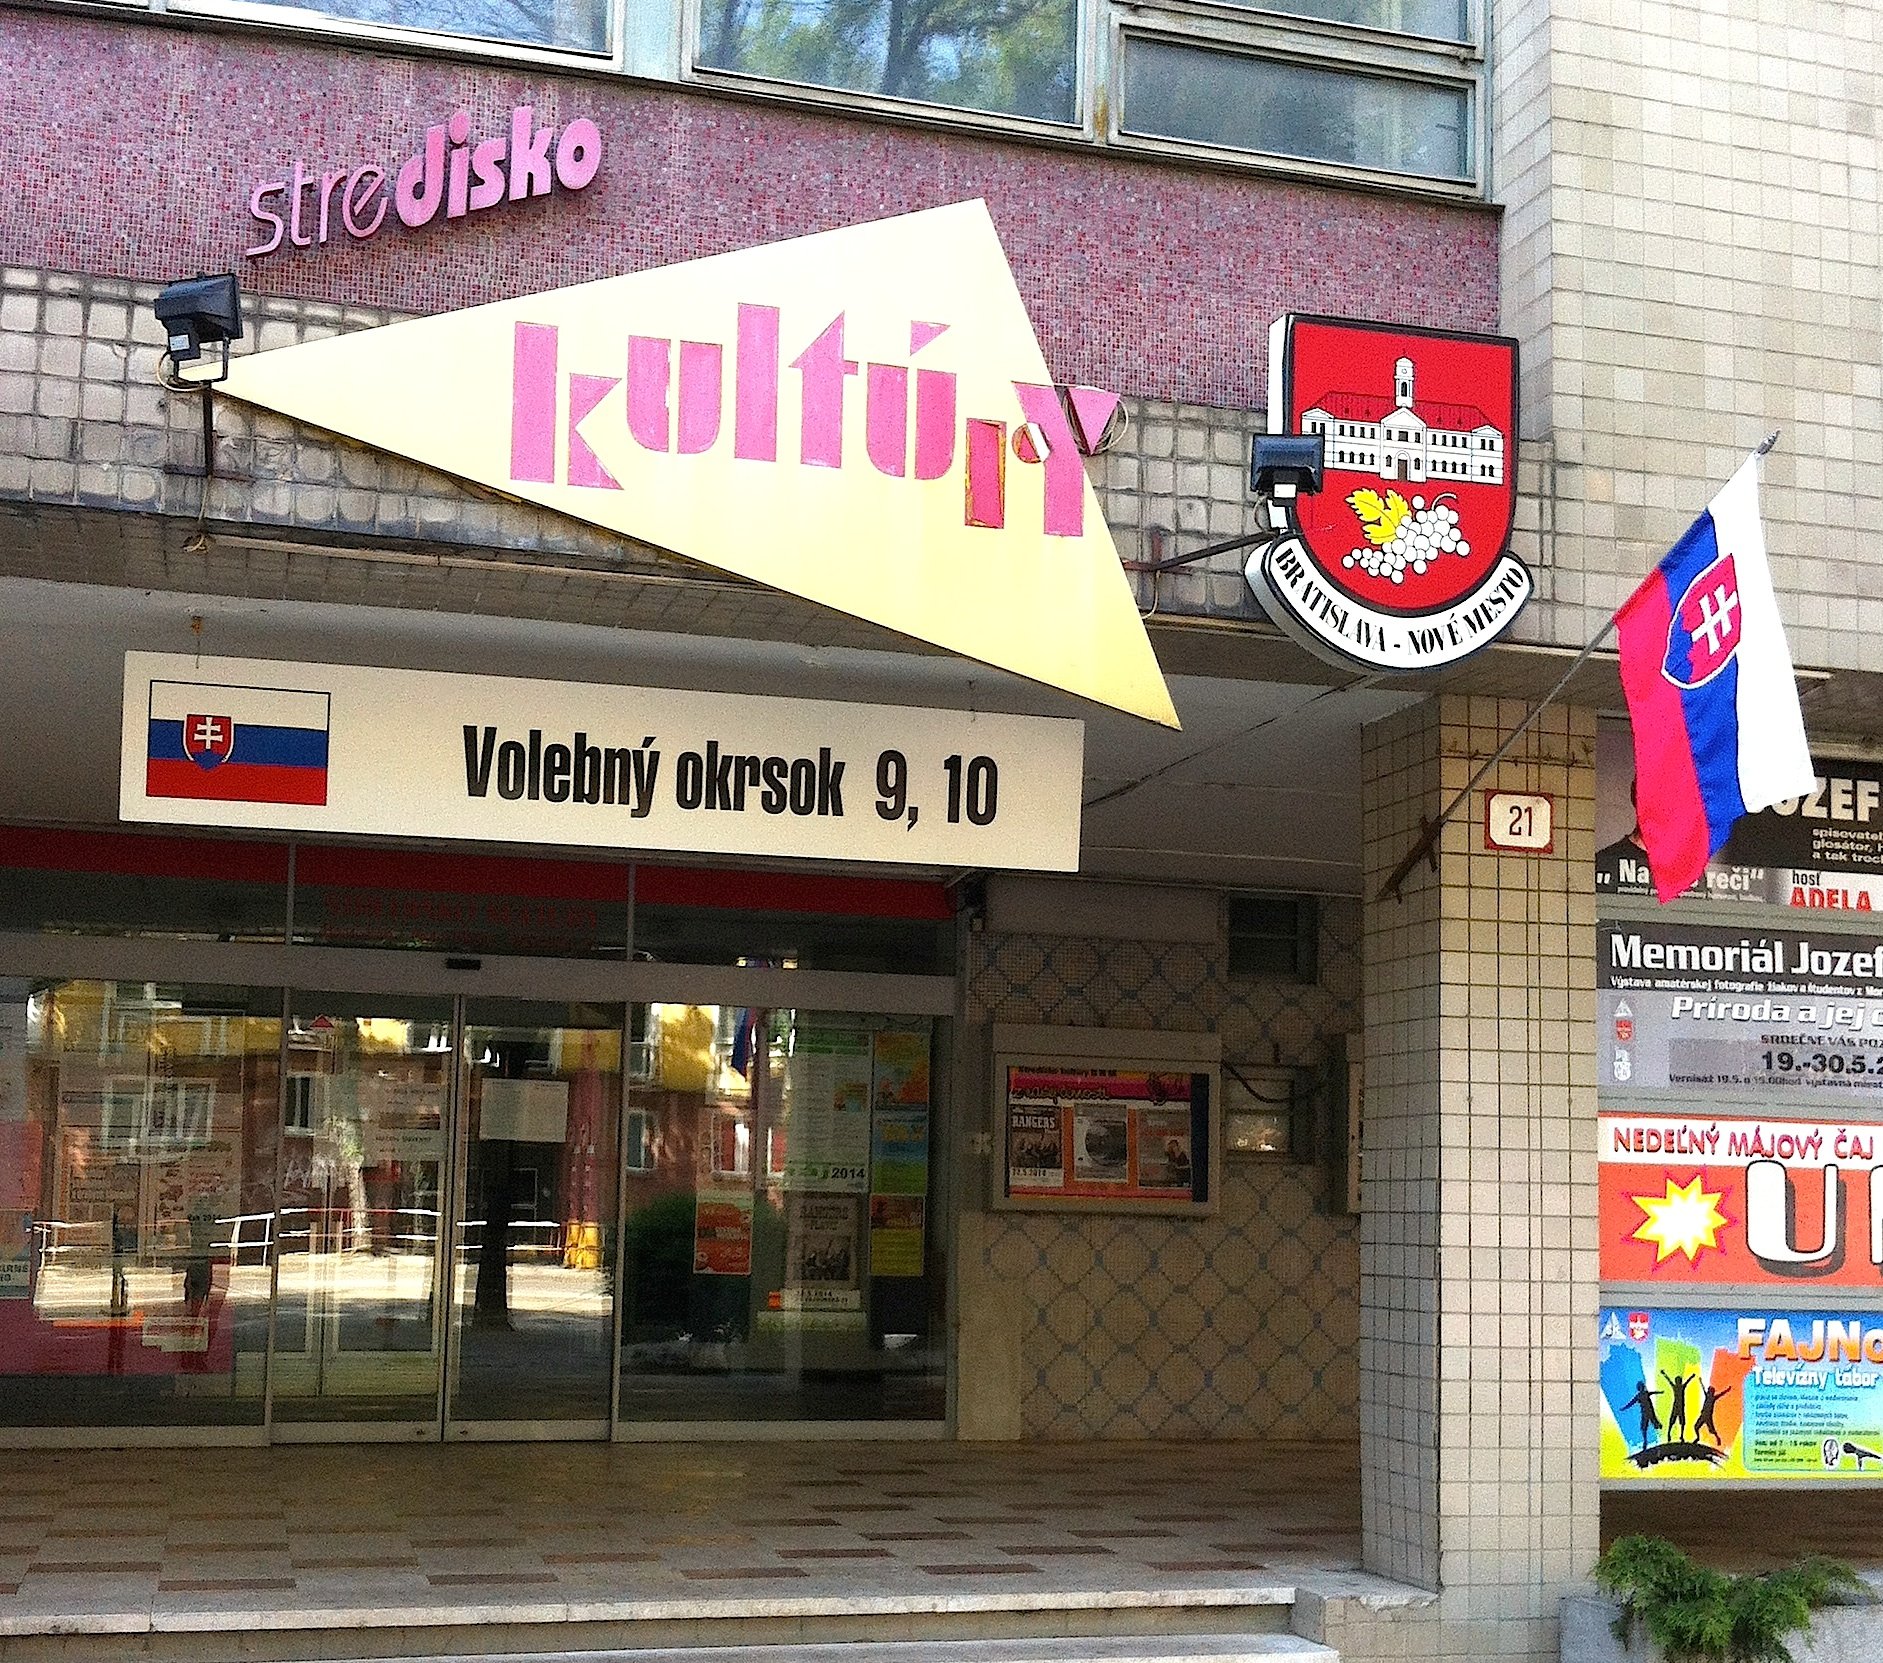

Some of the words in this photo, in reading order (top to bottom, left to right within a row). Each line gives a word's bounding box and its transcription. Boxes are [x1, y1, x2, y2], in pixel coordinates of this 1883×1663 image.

[246, 105, 601, 257] stredisko
[510, 302, 1121, 536] kultúry
[1275, 548, 1386, 652] BRATISLAVA
[1408, 613, 1463, 655] NOVÉ
[1463, 567, 1524, 639] MESTO
[463, 725, 660, 819] Volebný
[676, 741, 845, 817] okrsok
[876, 750, 919, 832] 9,
[944, 754, 998, 826] 10
[1747, 776, 1880, 822] ZEF
[1509, 805, 1533, 836] 21
[1812, 851, 1821, 860] a
[1792, 869, 1820, 886] host
[1790, 887, 1872, 912] ADELA
[1610, 932, 1784, 975] Memoriál
[1610, 975, 1651, 988] Výstava
[1714, 979, 1764, 993] fotografie
[1671, 995, 1790, 1022] Príroda
[1798, 1005, 1817, 1023] a
[1819, 1001, 1867, 1031] jej
[1828, 1034, 1856, 1048] VÁS
[1613, 1123, 1720, 1155] NEDEĽNÝ
[1728, 1125, 1823, 1160] MÁJOVÝ
[1833, 1128, 1874, 1160] ČAJ
[831, 1167, 865, 1179] 2014
[1752, 1362, 1829, 1391] Televízny
[1834, 1363, 1880, 1388] tábor
